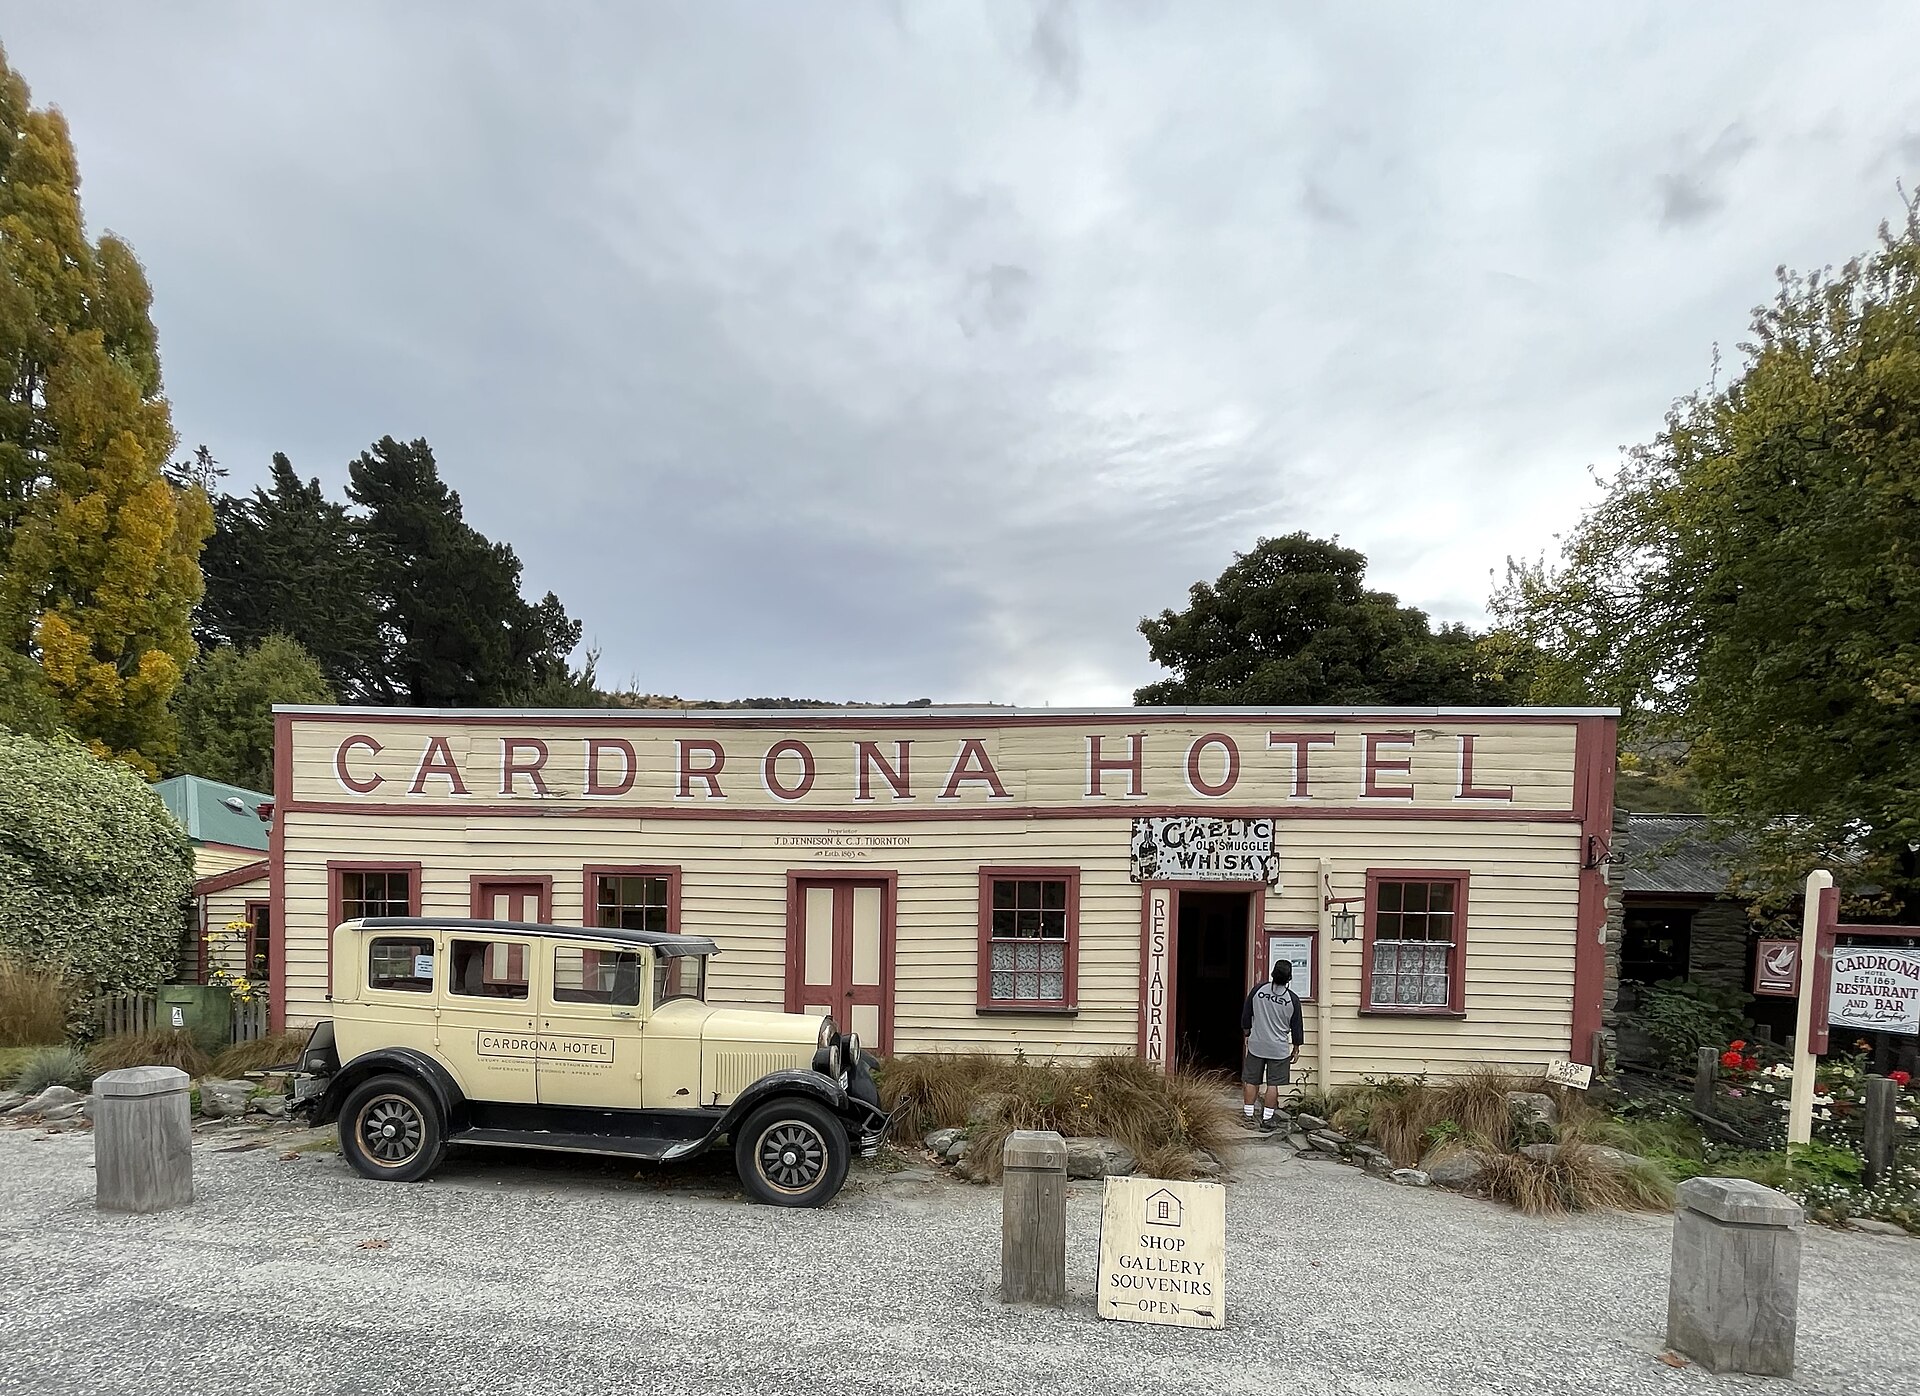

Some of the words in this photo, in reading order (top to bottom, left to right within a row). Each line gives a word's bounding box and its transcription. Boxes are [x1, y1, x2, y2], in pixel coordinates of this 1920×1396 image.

[334, 734, 1014, 802] CARDRONA
[1084, 731, 1513, 803] HOTEL
[836, 837, 842, 846] &
[865, 837, 910, 846] THORNTON
[1162, 821, 1270, 848] GAELIC
[1176, 851, 1271, 870] WHISKY
[1835, 955, 1920, 980] CARDRONA
[1874, 976, 1896, 985] 1863
[1835, 983, 1918, 999] RESTAURANT
[1846, 999, 1868, 1008] AND
[1874, 998, 1905, 1012] BAR
[483, 1037, 557, 1052] CARDRONA
[563, 1042, 607, 1055] HOTEL
[1554, 1060, 1585, 1071] PLEASE
[1140, 1234, 1186, 1251] SHOP
[1119, 1255, 1205, 1276] GALLERY
[1110, 1273, 1212, 1296] SOUVENIRS
[1138, 1299, 1181, 1315] OPEN
